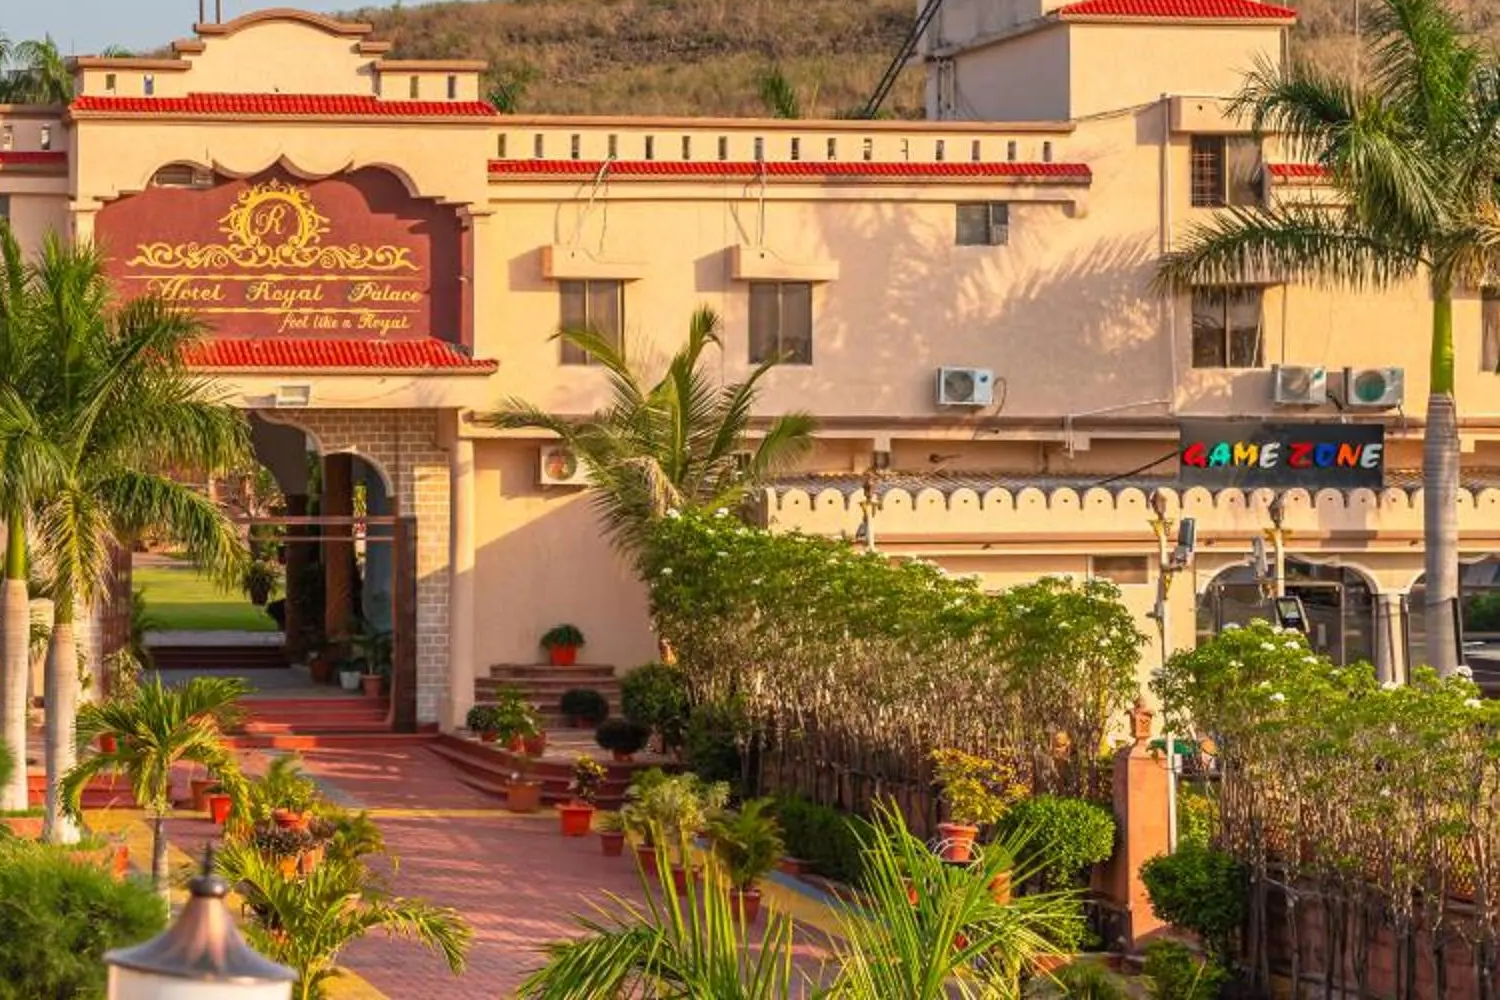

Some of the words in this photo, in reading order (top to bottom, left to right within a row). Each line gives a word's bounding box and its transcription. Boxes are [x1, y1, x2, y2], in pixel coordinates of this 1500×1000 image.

[255, 203, 288, 235] R
[147, 277, 226, 301] Hotel
[245, 281, 323, 308] Royal
[347, 281, 422, 302] Palace
[313, 314, 339, 329] like
[342, 319, 352, 329] a
[357, 311, 411, 337] Royal
[1183, 441, 1280, 468] GAME
[1288, 442, 1383, 468] ZONE
